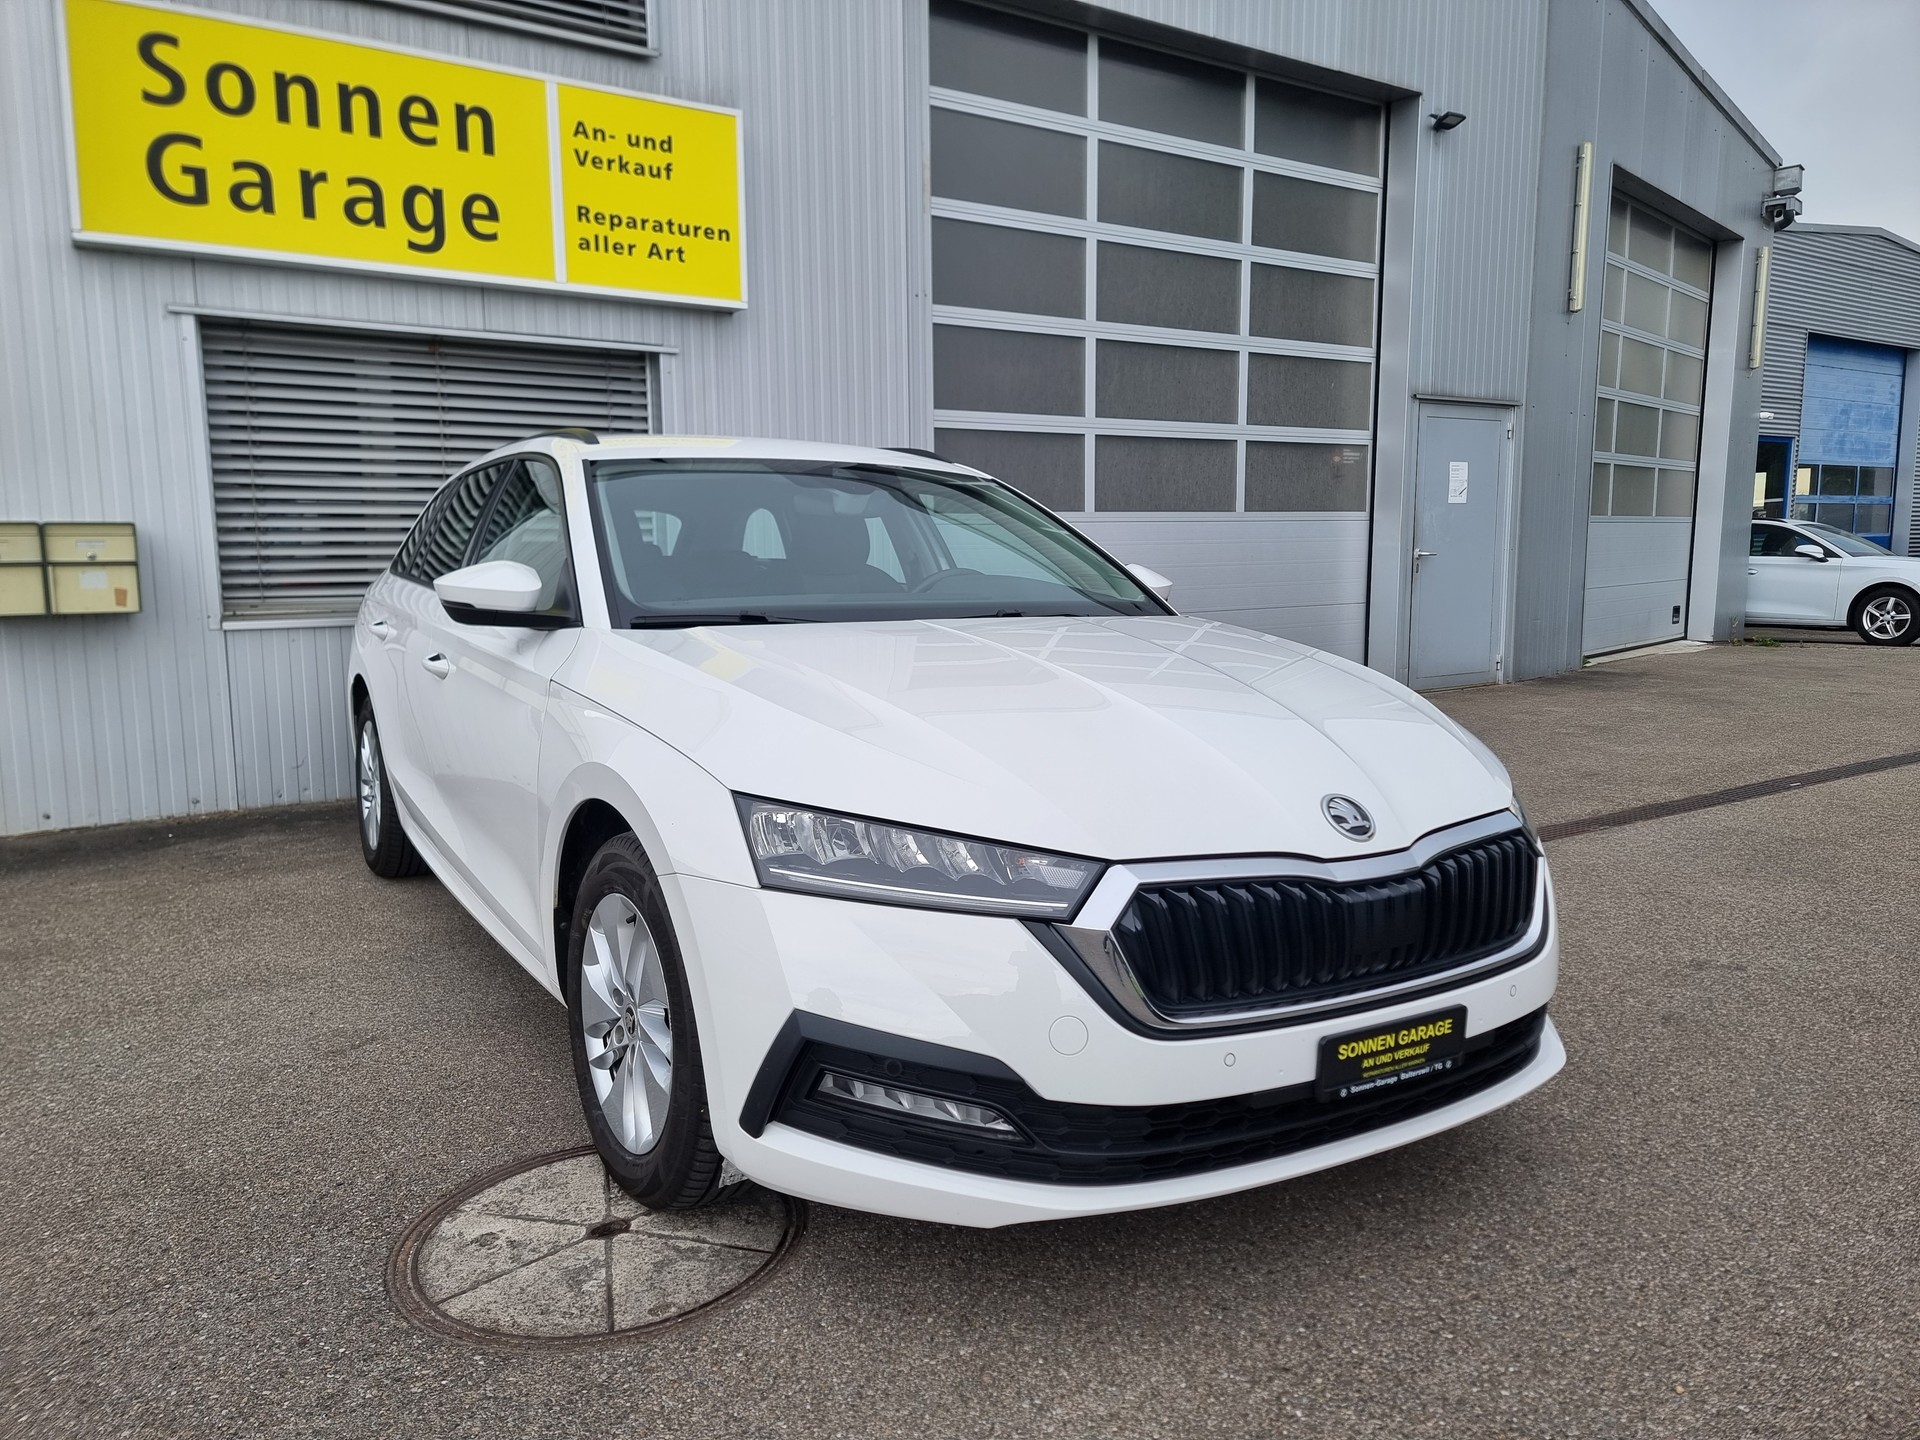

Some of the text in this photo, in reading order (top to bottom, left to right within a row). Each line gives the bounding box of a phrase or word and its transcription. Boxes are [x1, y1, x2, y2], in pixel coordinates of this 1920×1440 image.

[137, 32, 495, 157] Sonnen
[573, 120, 673, 154] An- und
[574, 148, 673, 181] Verkauf
[145, 132, 500, 254] Garage
[577, 205, 731, 242] Reparaturen
[578, 234, 685, 263] aller Art
[1338, 1019, 1453, 1060] SONNEN GARAGE
[1362, 1043, 1430, 1068] AN UND VERKAUF
[1350, 1076, 1398, 1093] Sonnen-Garage
[1434, 1063, 1443, 1071] TG
